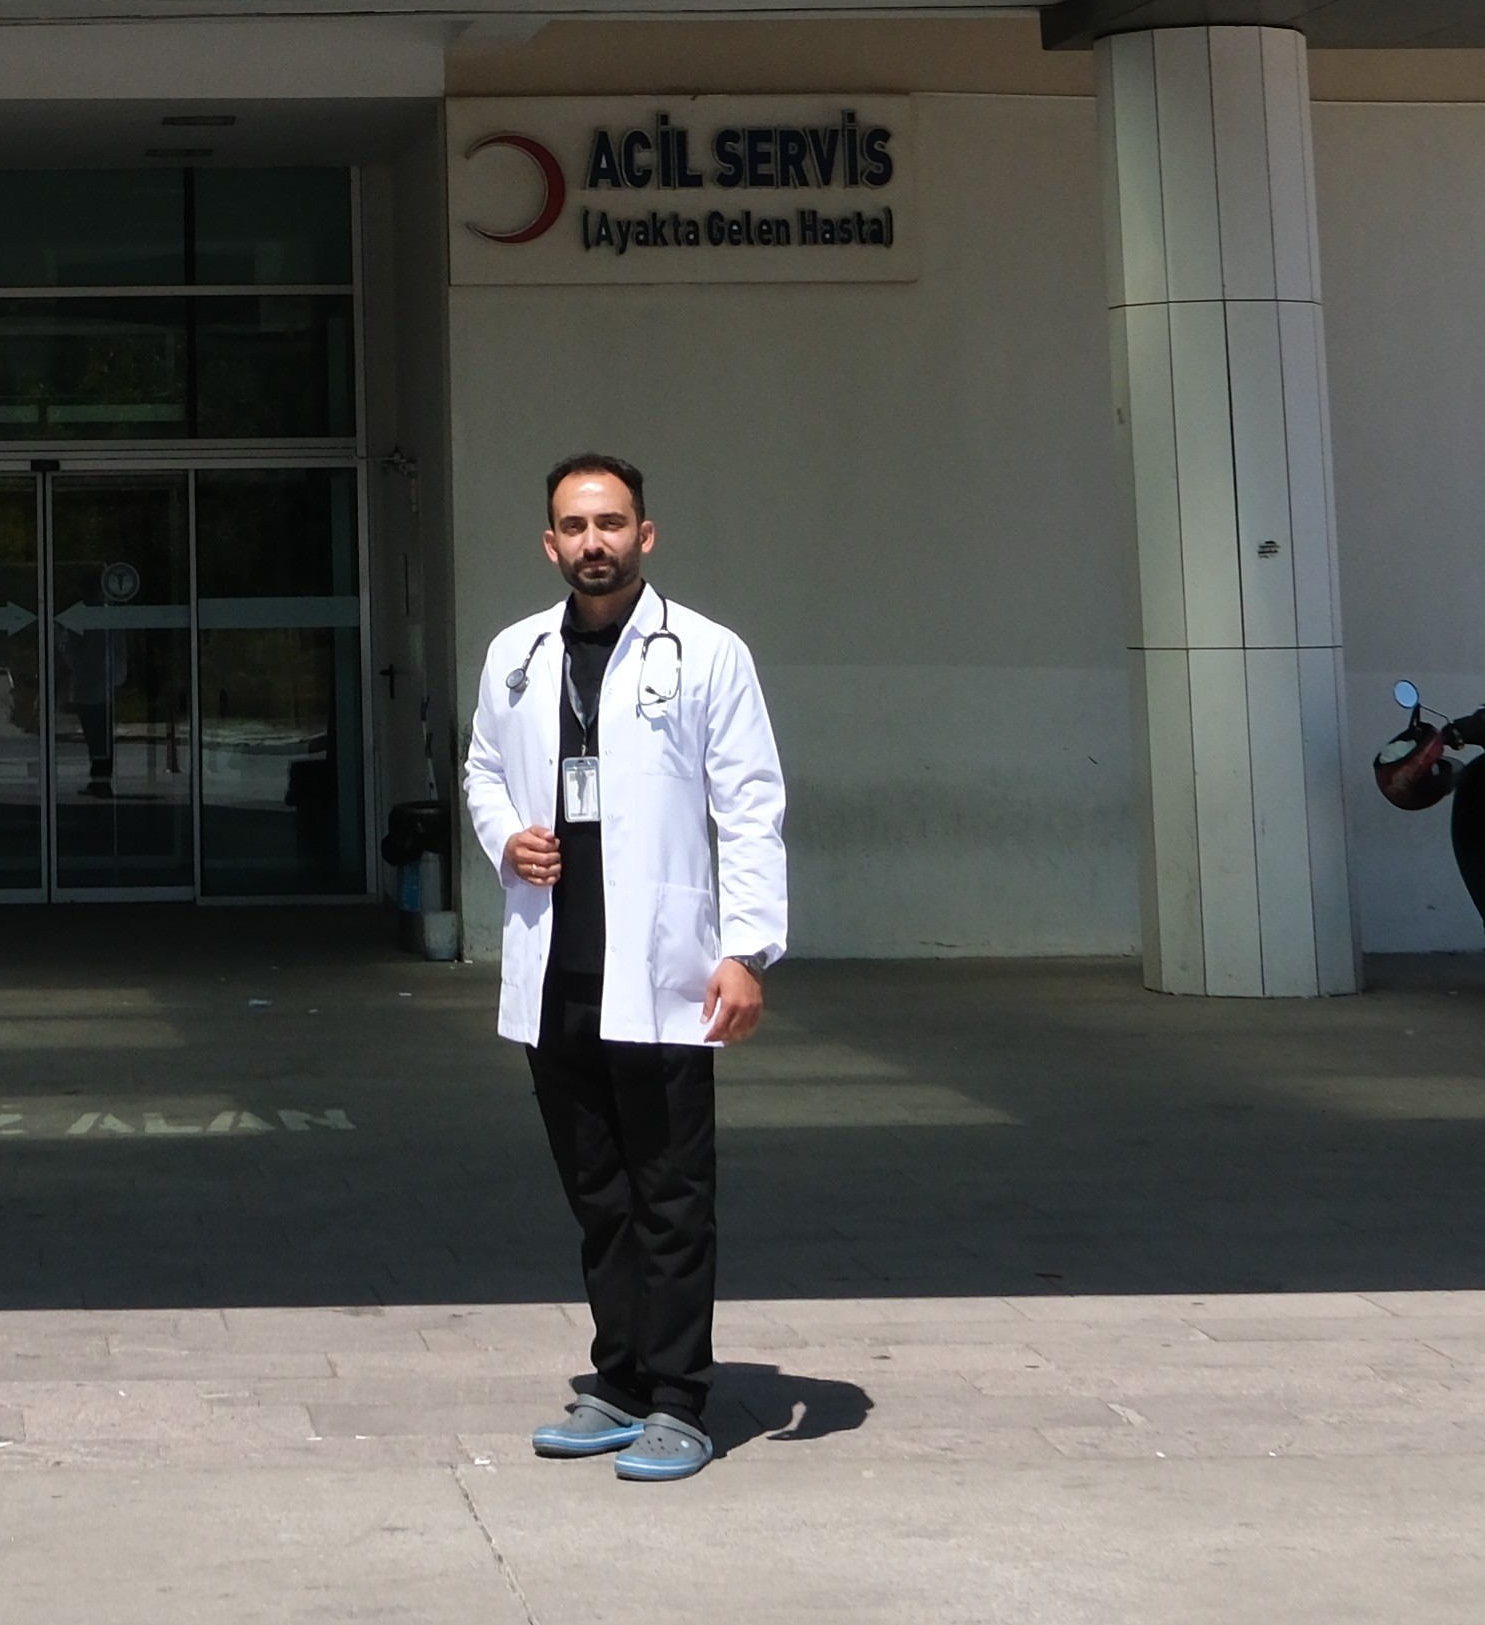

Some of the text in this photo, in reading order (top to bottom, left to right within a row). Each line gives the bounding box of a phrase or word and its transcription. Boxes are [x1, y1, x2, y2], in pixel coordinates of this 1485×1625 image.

[585, 109, 894, 189] ACİL SERVİS
[581, 205, 895, 255] (Ayakta Gelen Hasta)
[65, 1108, 357, 1136] ALAN
